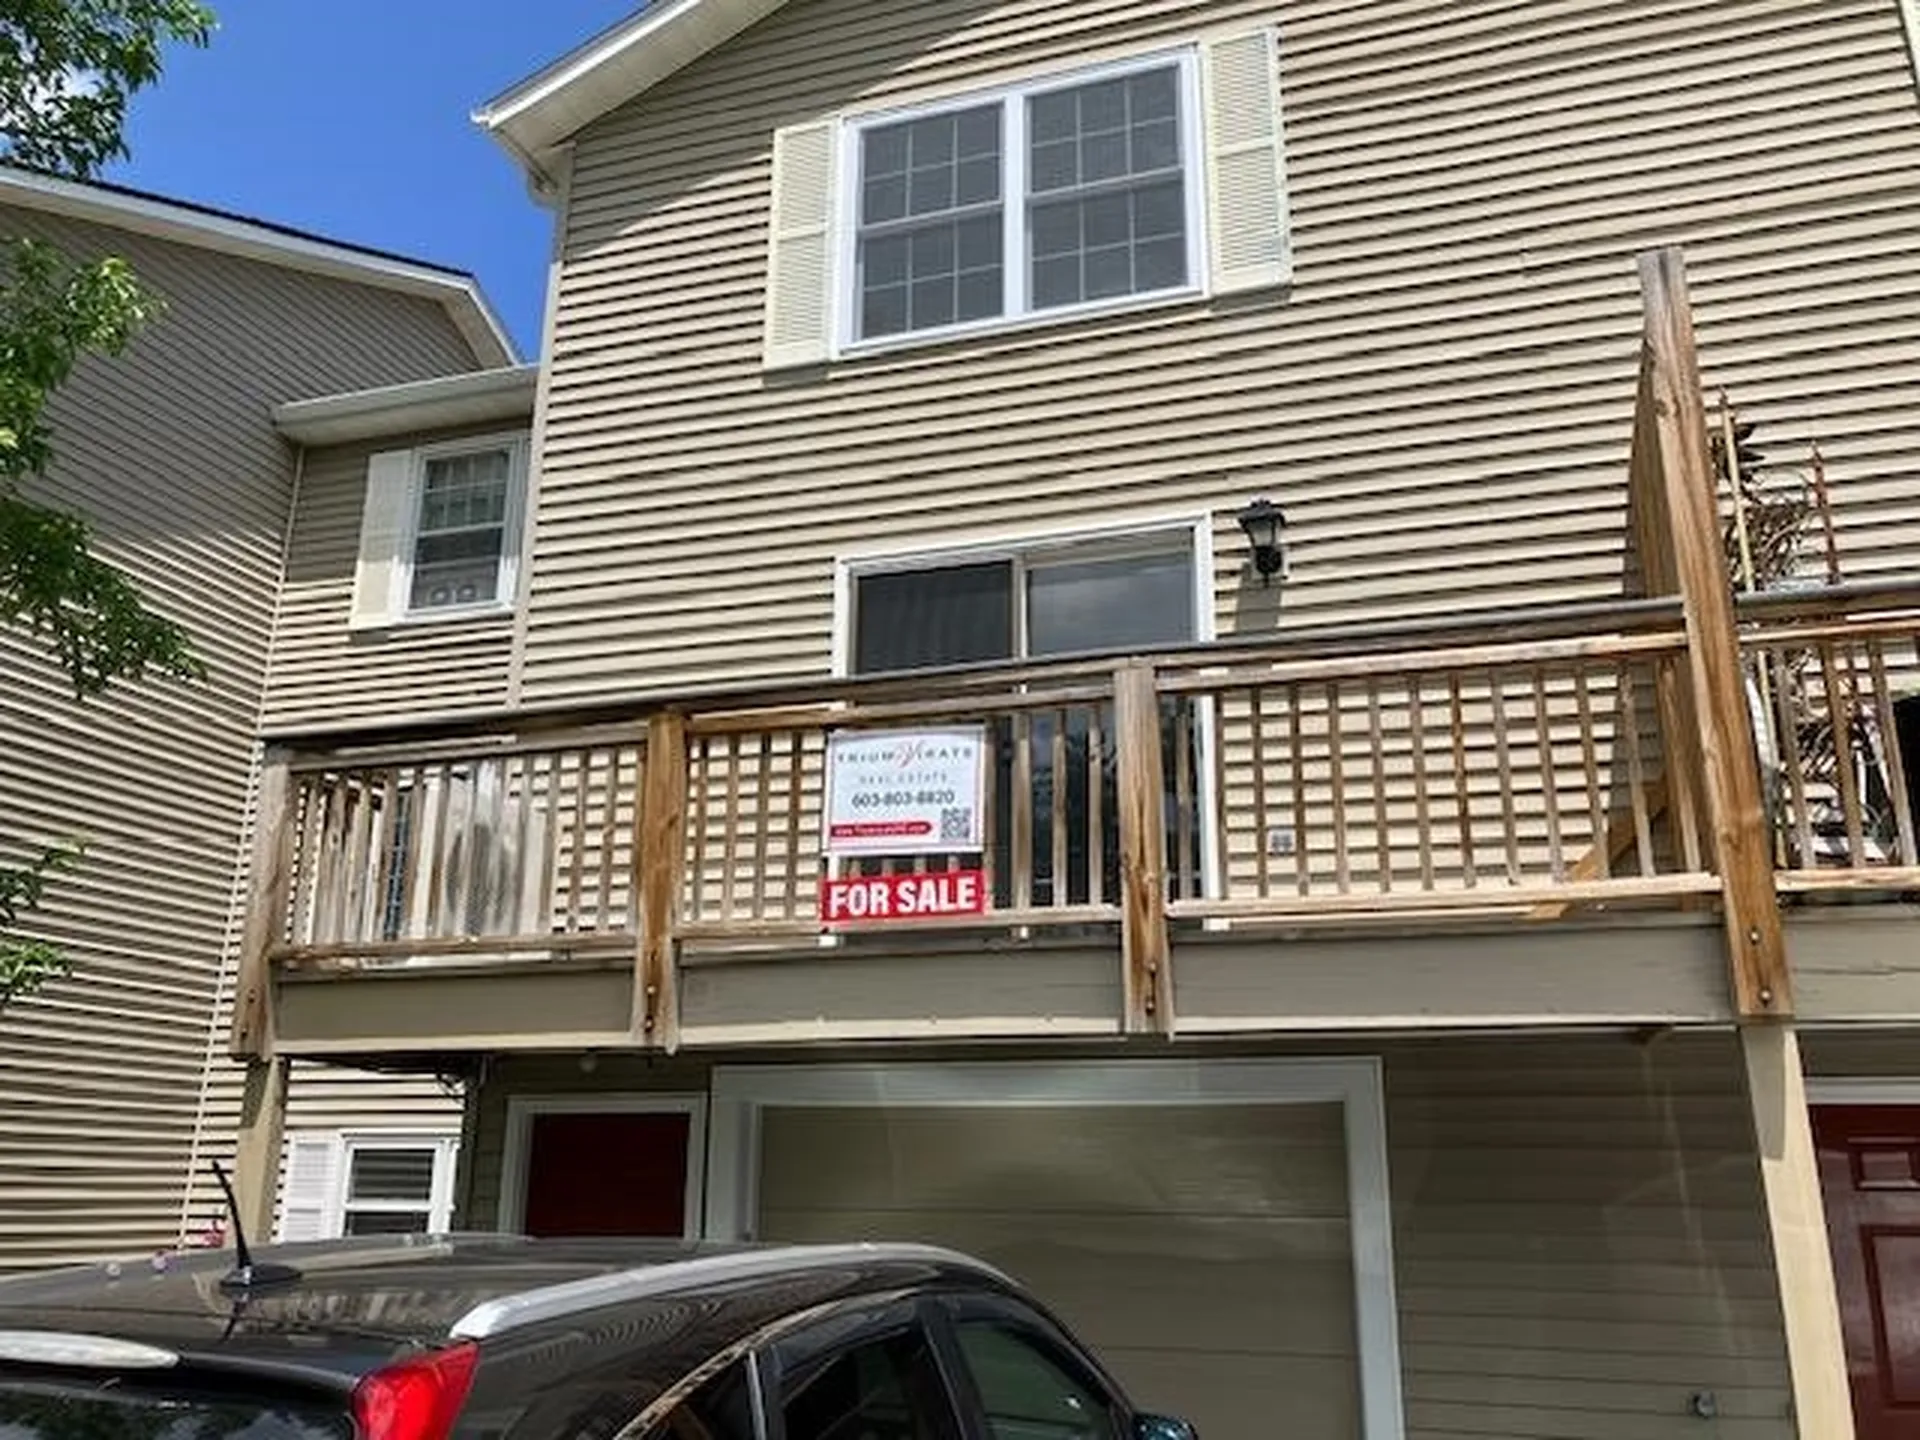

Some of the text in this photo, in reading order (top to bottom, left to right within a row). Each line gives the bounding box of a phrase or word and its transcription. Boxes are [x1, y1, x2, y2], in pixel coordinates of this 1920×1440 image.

[851, 789, 955, 808] 603-803-8820
[829, 876, 977, 918] FOR SALE
